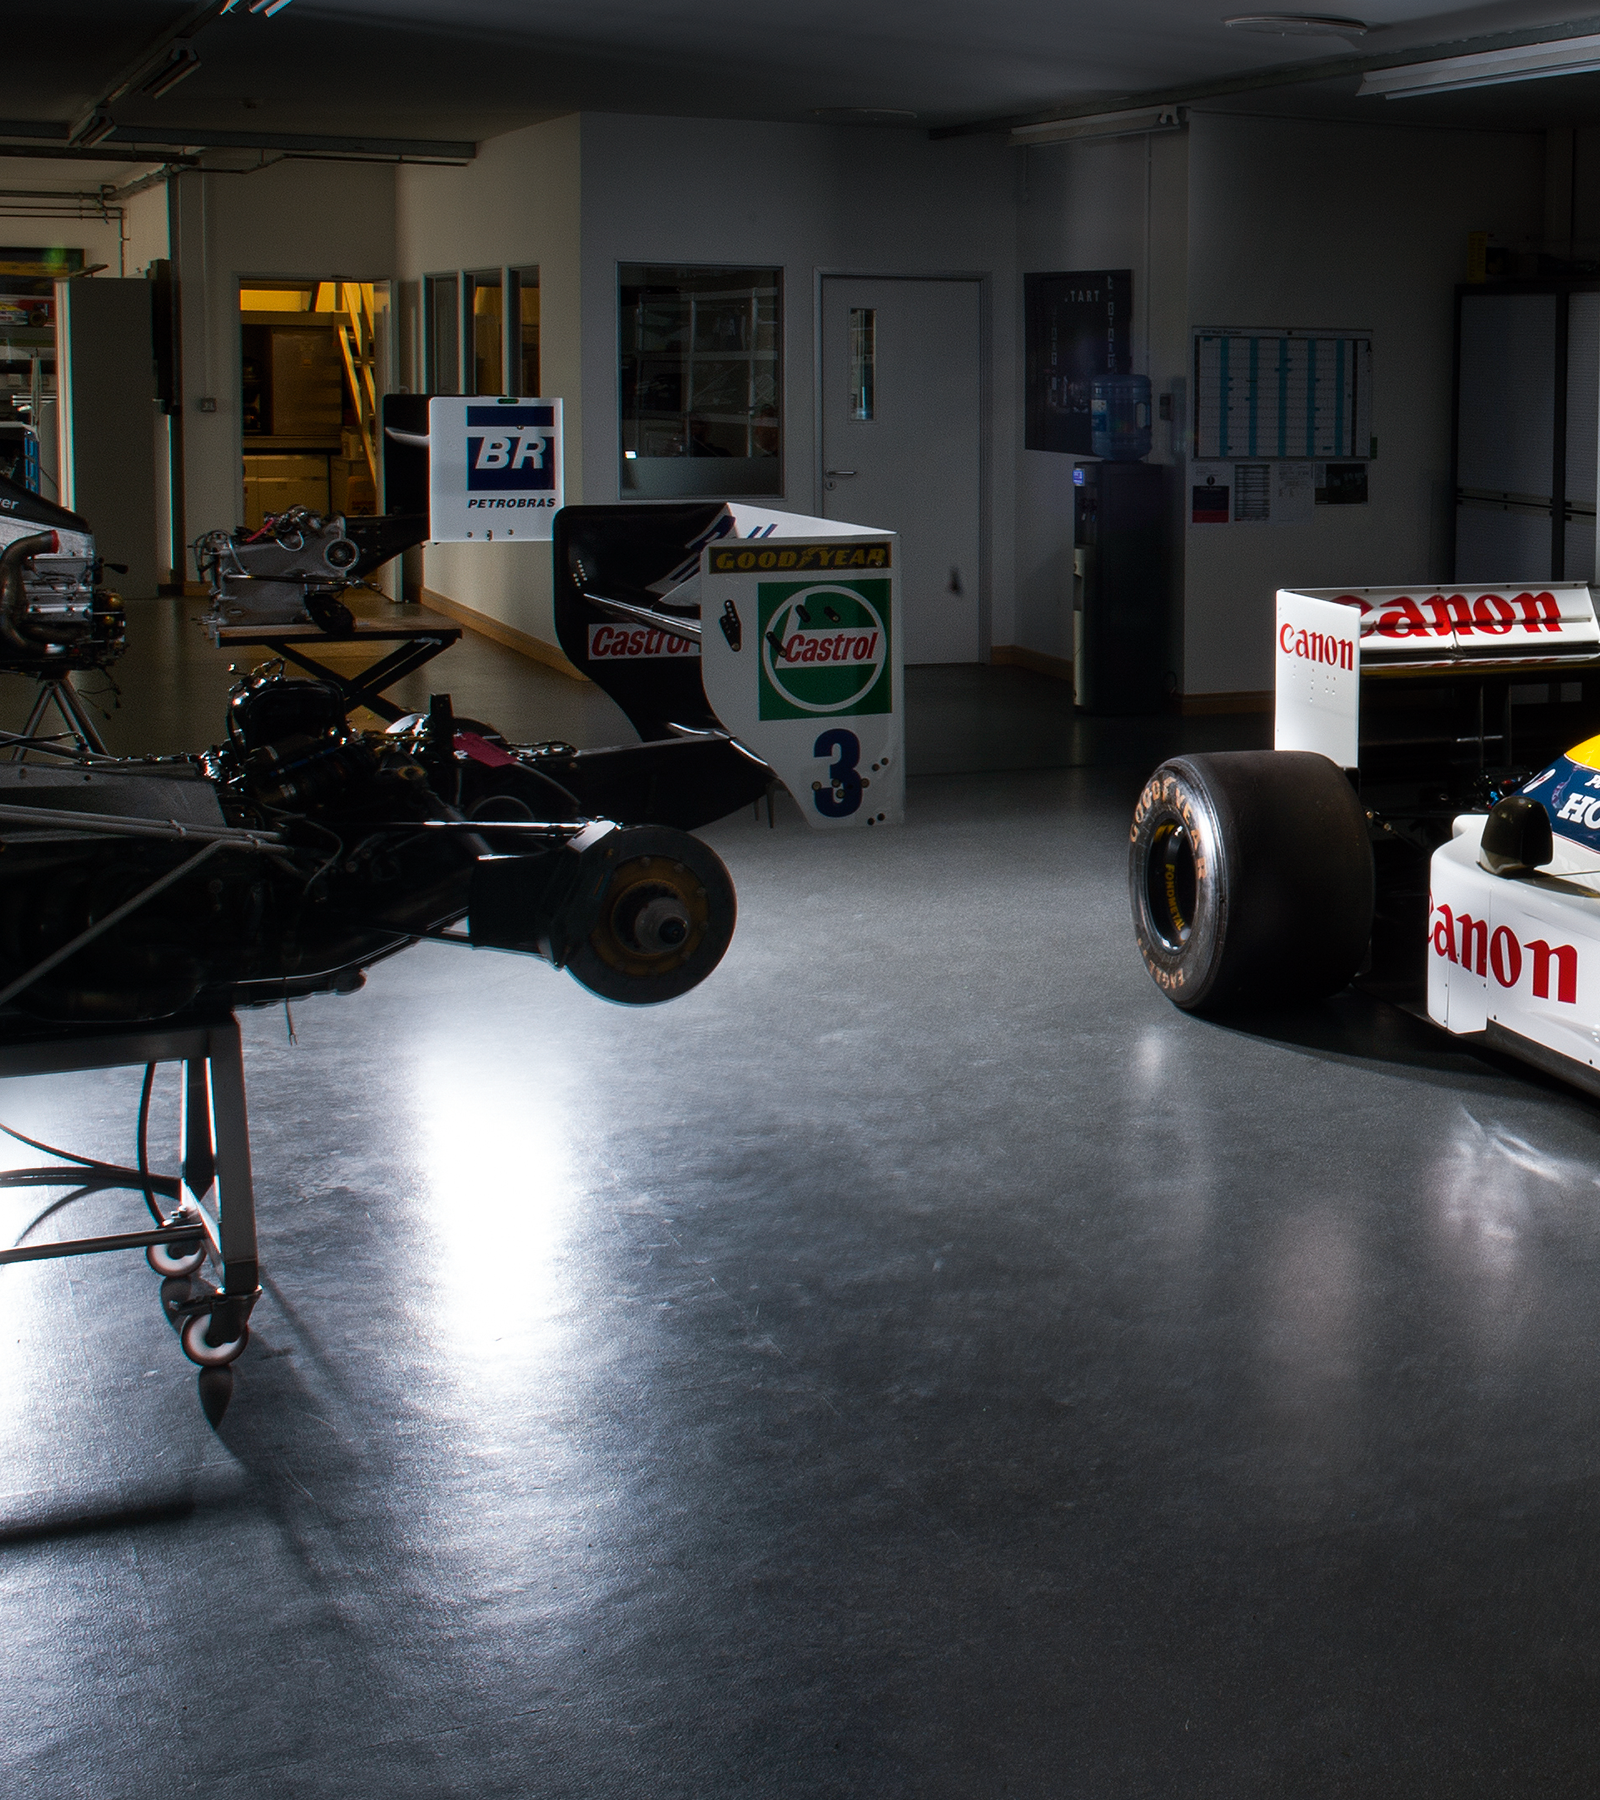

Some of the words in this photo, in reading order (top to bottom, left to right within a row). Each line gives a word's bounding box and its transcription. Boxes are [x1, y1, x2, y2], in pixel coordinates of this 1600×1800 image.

[475, 436, 546, 469] BR
[0, 497, 19, 511] er
[467, 498, 556, 509] PETROBRAS
[716, 546, 887, 570] GOODYEAR
[785, 632, 879, 664] Castrol
[1280, 622, 1354, 672] Canon
[813, 728, 863, 819] 3
[1165, 863, 1185, 932] FONDMETAL
[1429, 888, 1578, 1004] anon
